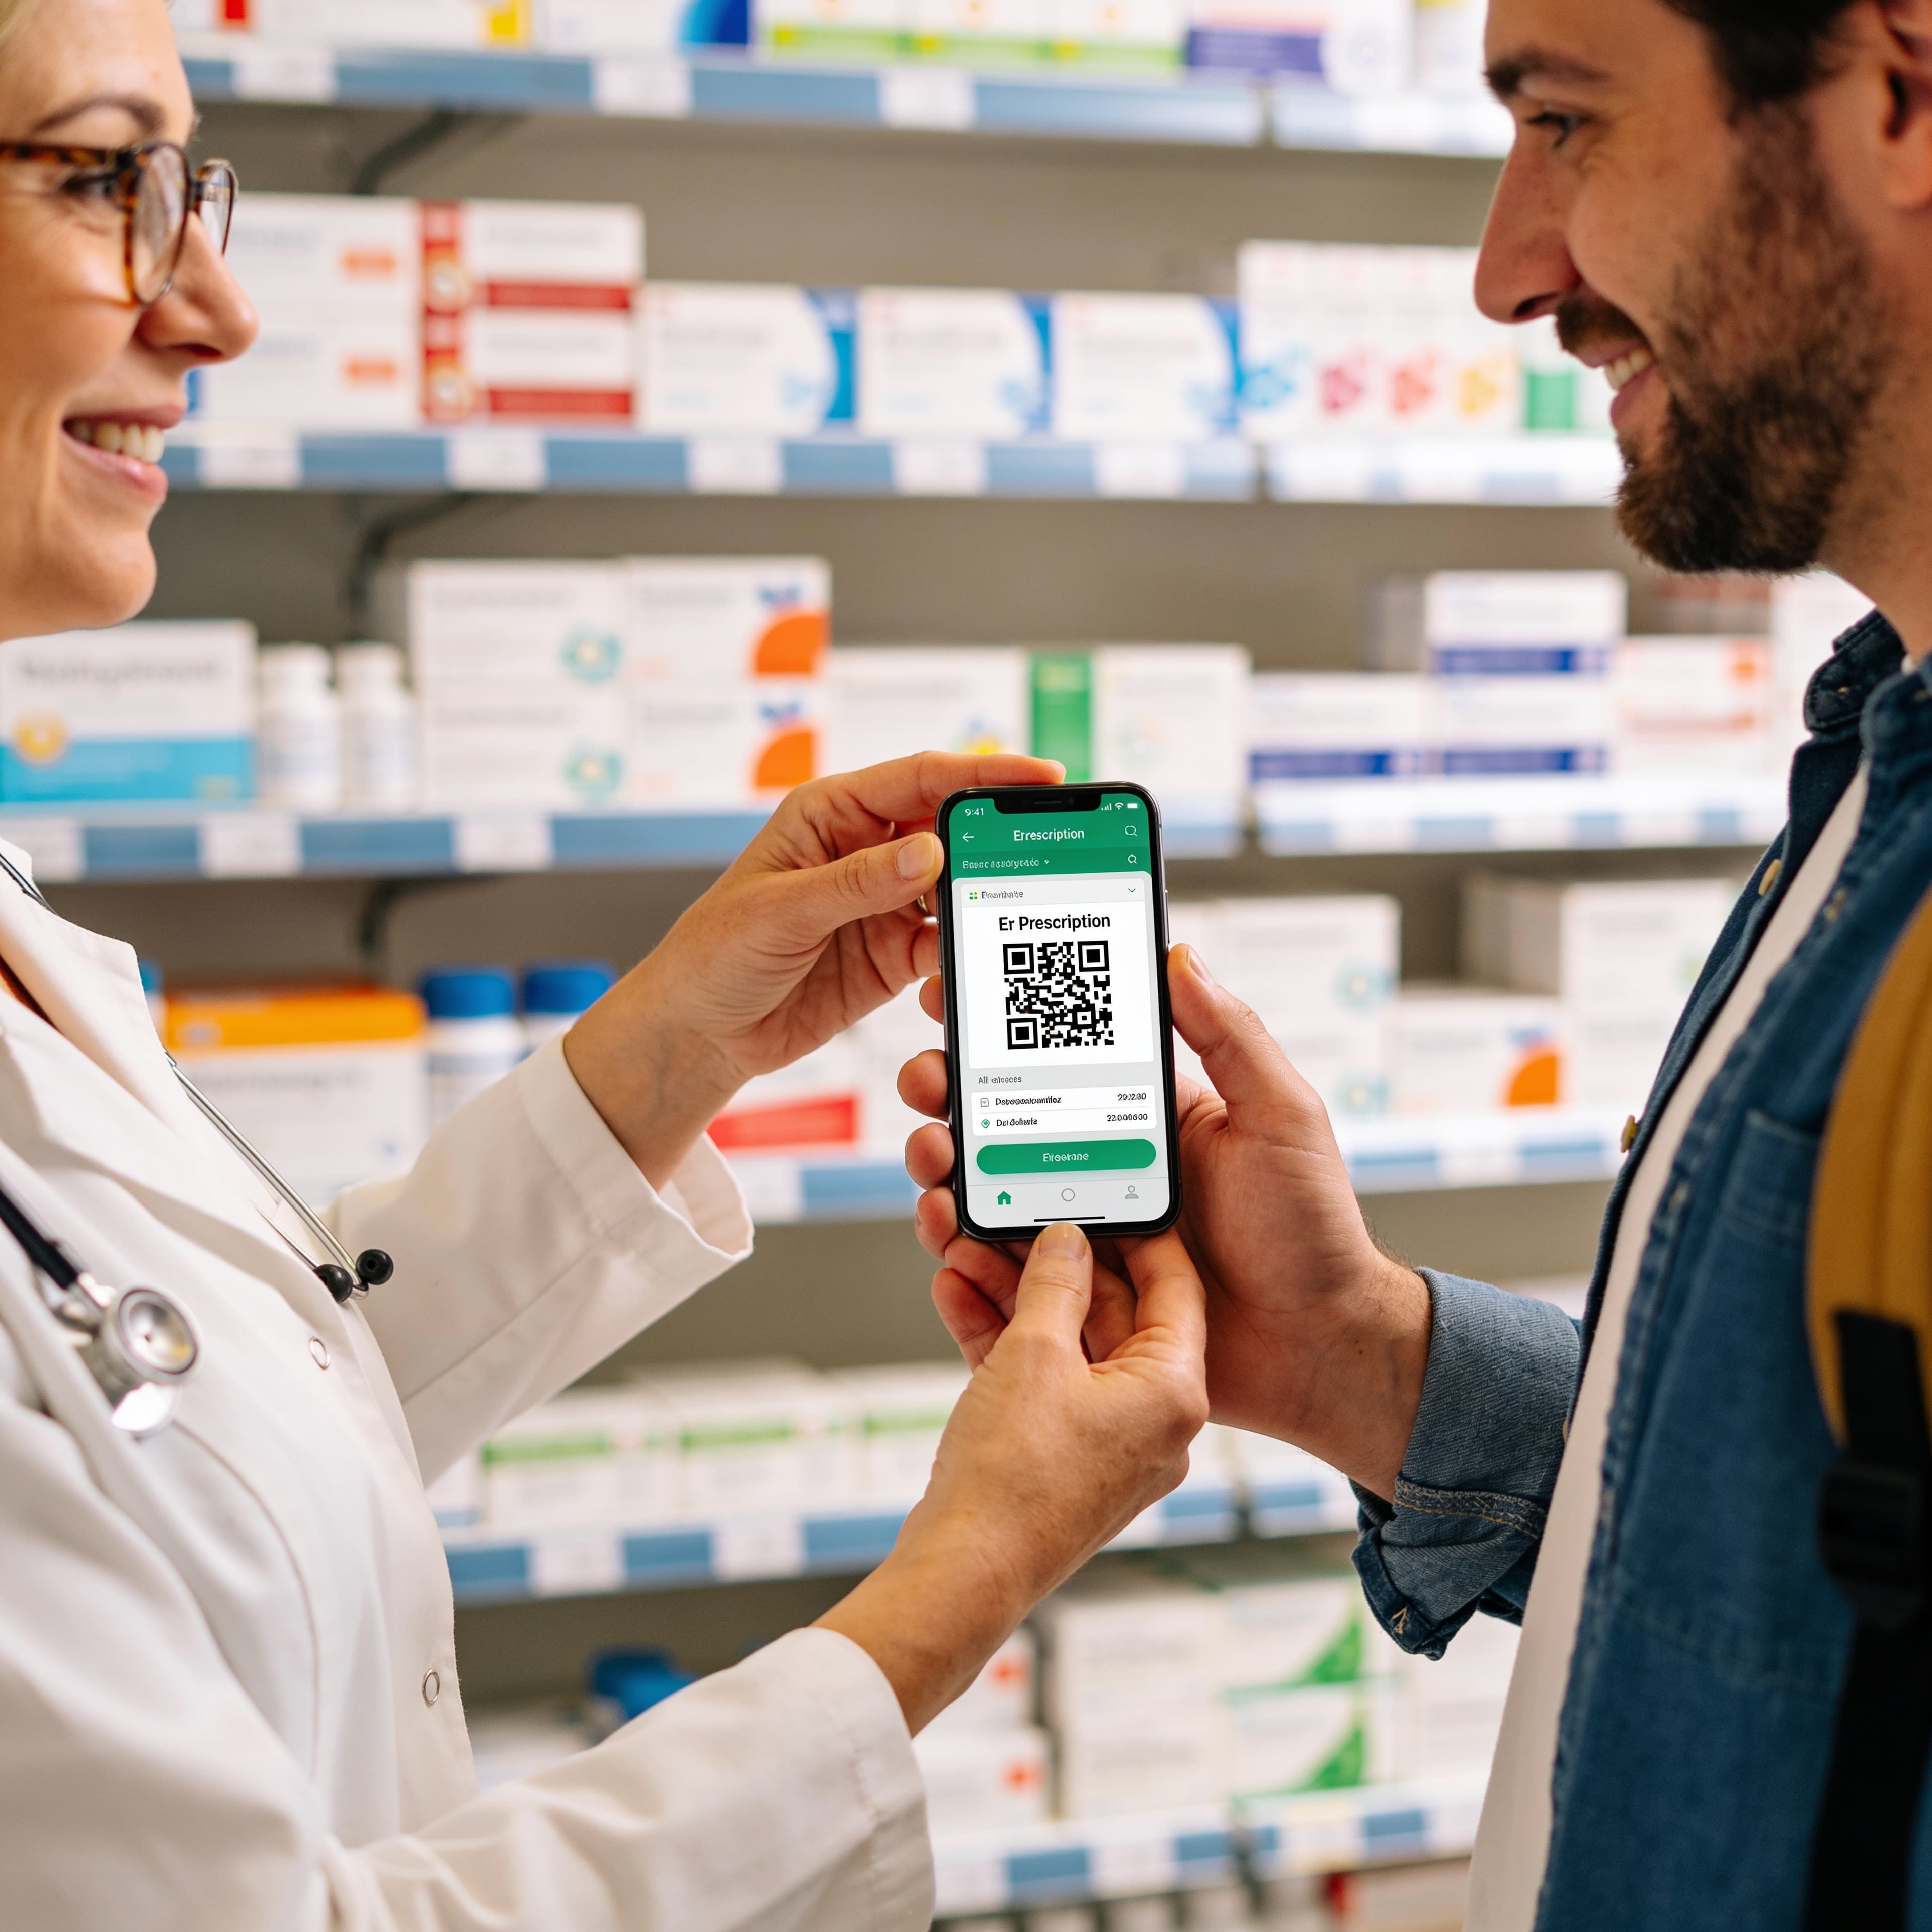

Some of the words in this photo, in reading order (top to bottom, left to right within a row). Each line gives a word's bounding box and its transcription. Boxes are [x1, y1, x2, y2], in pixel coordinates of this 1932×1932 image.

[964, 807, 984, 816] 9:41
[1013, 828, 1085, 842] Errescription
[999, 917, 1015, 931] Er
[1019, 913, 1111, 932] Prescription
